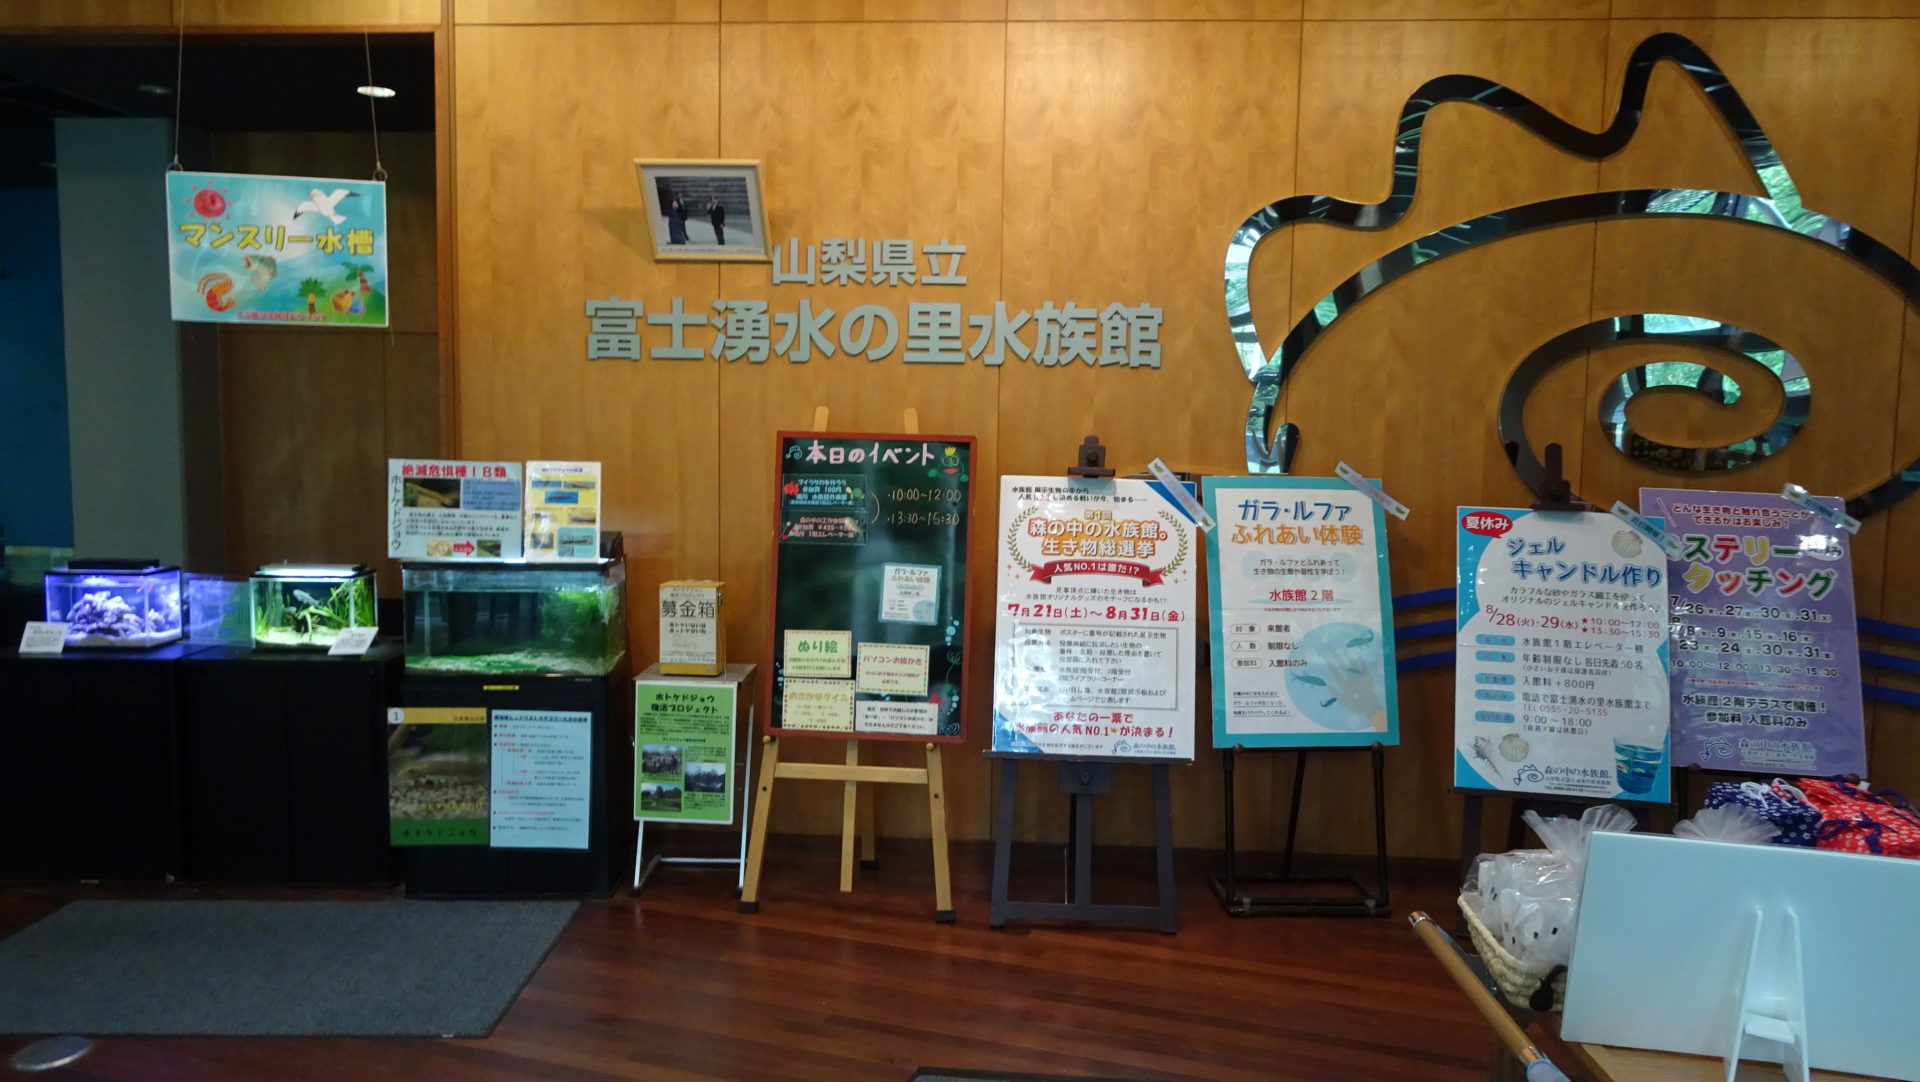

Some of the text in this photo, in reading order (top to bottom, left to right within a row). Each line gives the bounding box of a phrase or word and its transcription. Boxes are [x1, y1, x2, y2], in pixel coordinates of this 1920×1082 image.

[179, 223, 375, 255] マンスリー水槽
[771, 237, 967, 286] 山梨県立
[585, 296, 1164, 369] 富士湧水の里水族館
[805, 439, 935, 466] 本日のイベント
[390, 475, 402, 550] ホトケドジョウ
[1238, 499, 1353, 521] ガラ・ルファ
[1028, 517, 1168, 541] 森の中の水族館。
[1466, 516, 1509, 530] 夏休み
[1230, 523, 1364, 546] ふれあい体験
[1041, 538, 1156, 558] 生き物総選挙
[1507, 537, 1566, 557] ジェル
[1682, 536, 1802, 565] ステリー
[1512, 560, 1662, 588] キャンドル作り
[1683, 564, 1836, 599] タッチング
[661, 600, 715, 618] 募金箱
[1267, 624, 1291, 632] 来館者
[797, 640, 838, 654] ぬり絵
[1268, 642, 1299, 650] 制限なし
[863, 655, 923, 665] パソコンお絵かき
[1268, 660, 1308, 668] 入館料のみ
[656, 692, 715, 703] ホトケドジョウ
[651, 703, 719, 713] 復活プロジェクト
[1053, 711, 1134, 724] あなたの一票で
[1706, 712, 1808, 728] 参加料 入館料のみ
